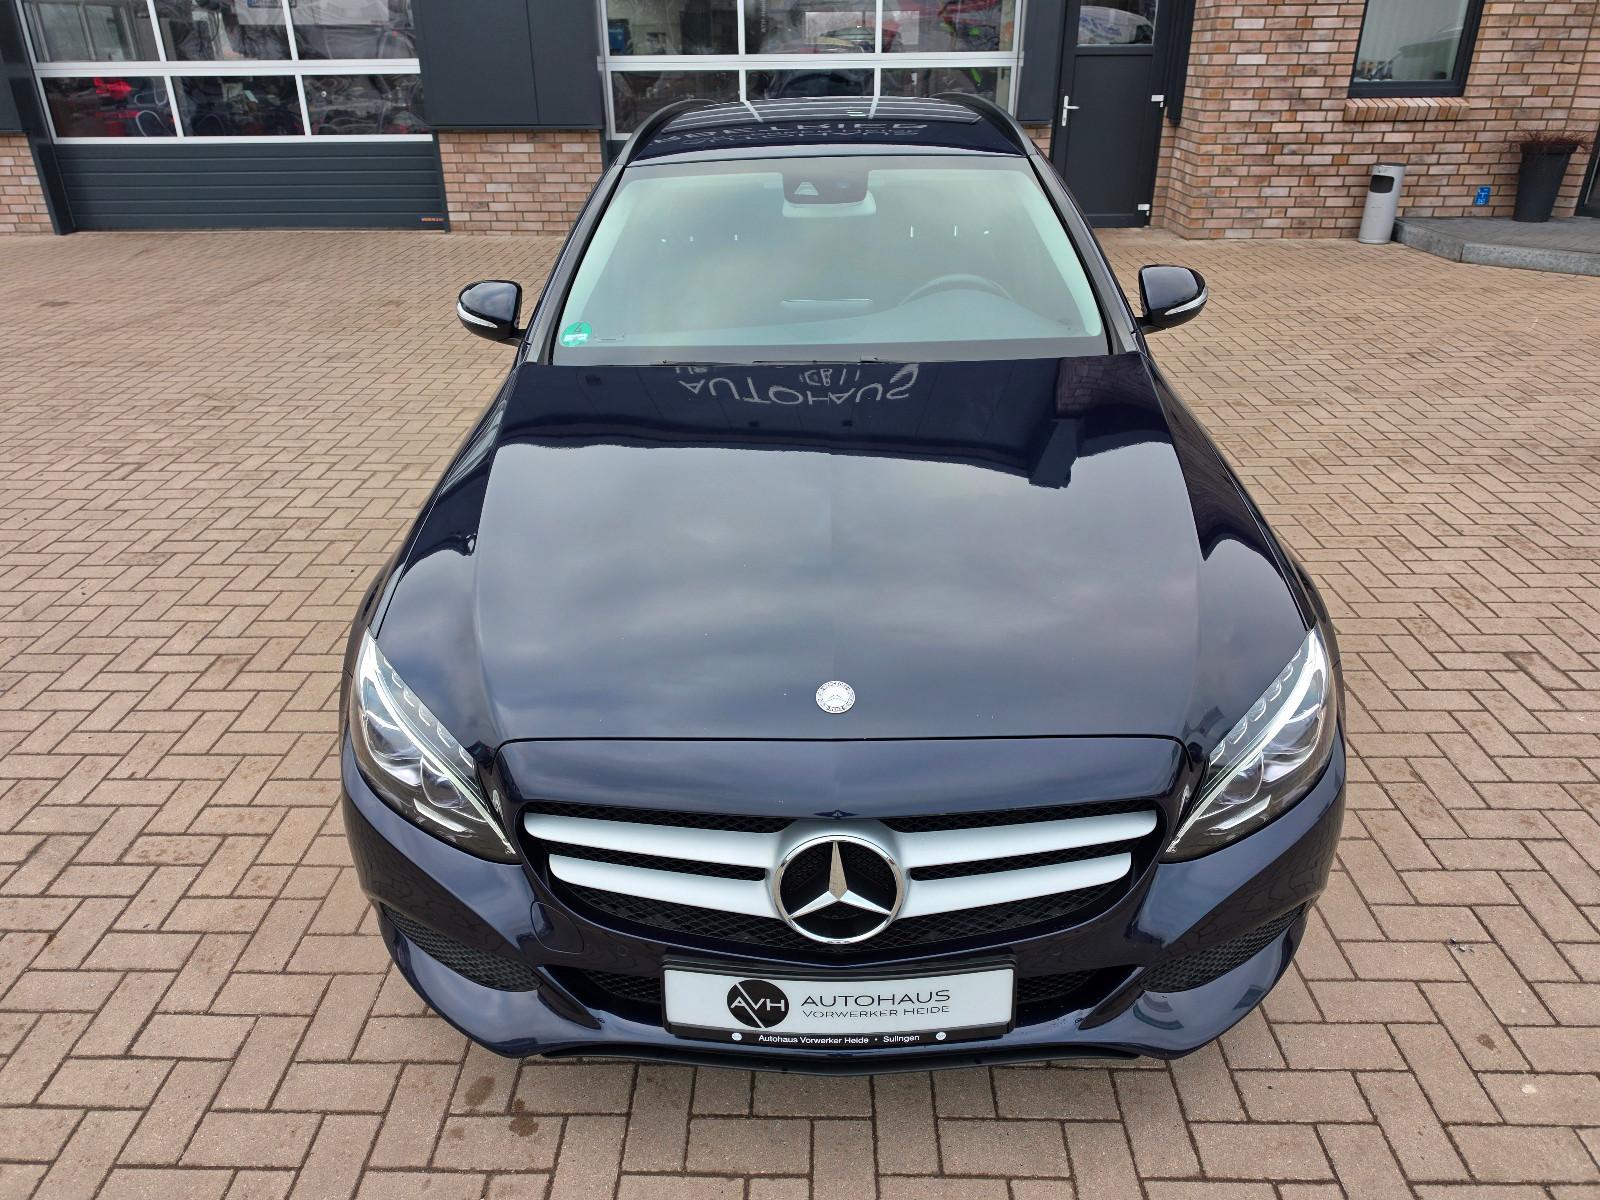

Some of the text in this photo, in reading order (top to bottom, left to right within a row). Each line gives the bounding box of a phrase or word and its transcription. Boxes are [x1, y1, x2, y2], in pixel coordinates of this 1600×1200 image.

[801, 989, 951, 1007] AUTOHAUS
[802, 1005, 950, 1018] VORWERKER HEIDE
[758, 1034, 920, 1044] Autohaus Vorwerker Heide Sulingen
